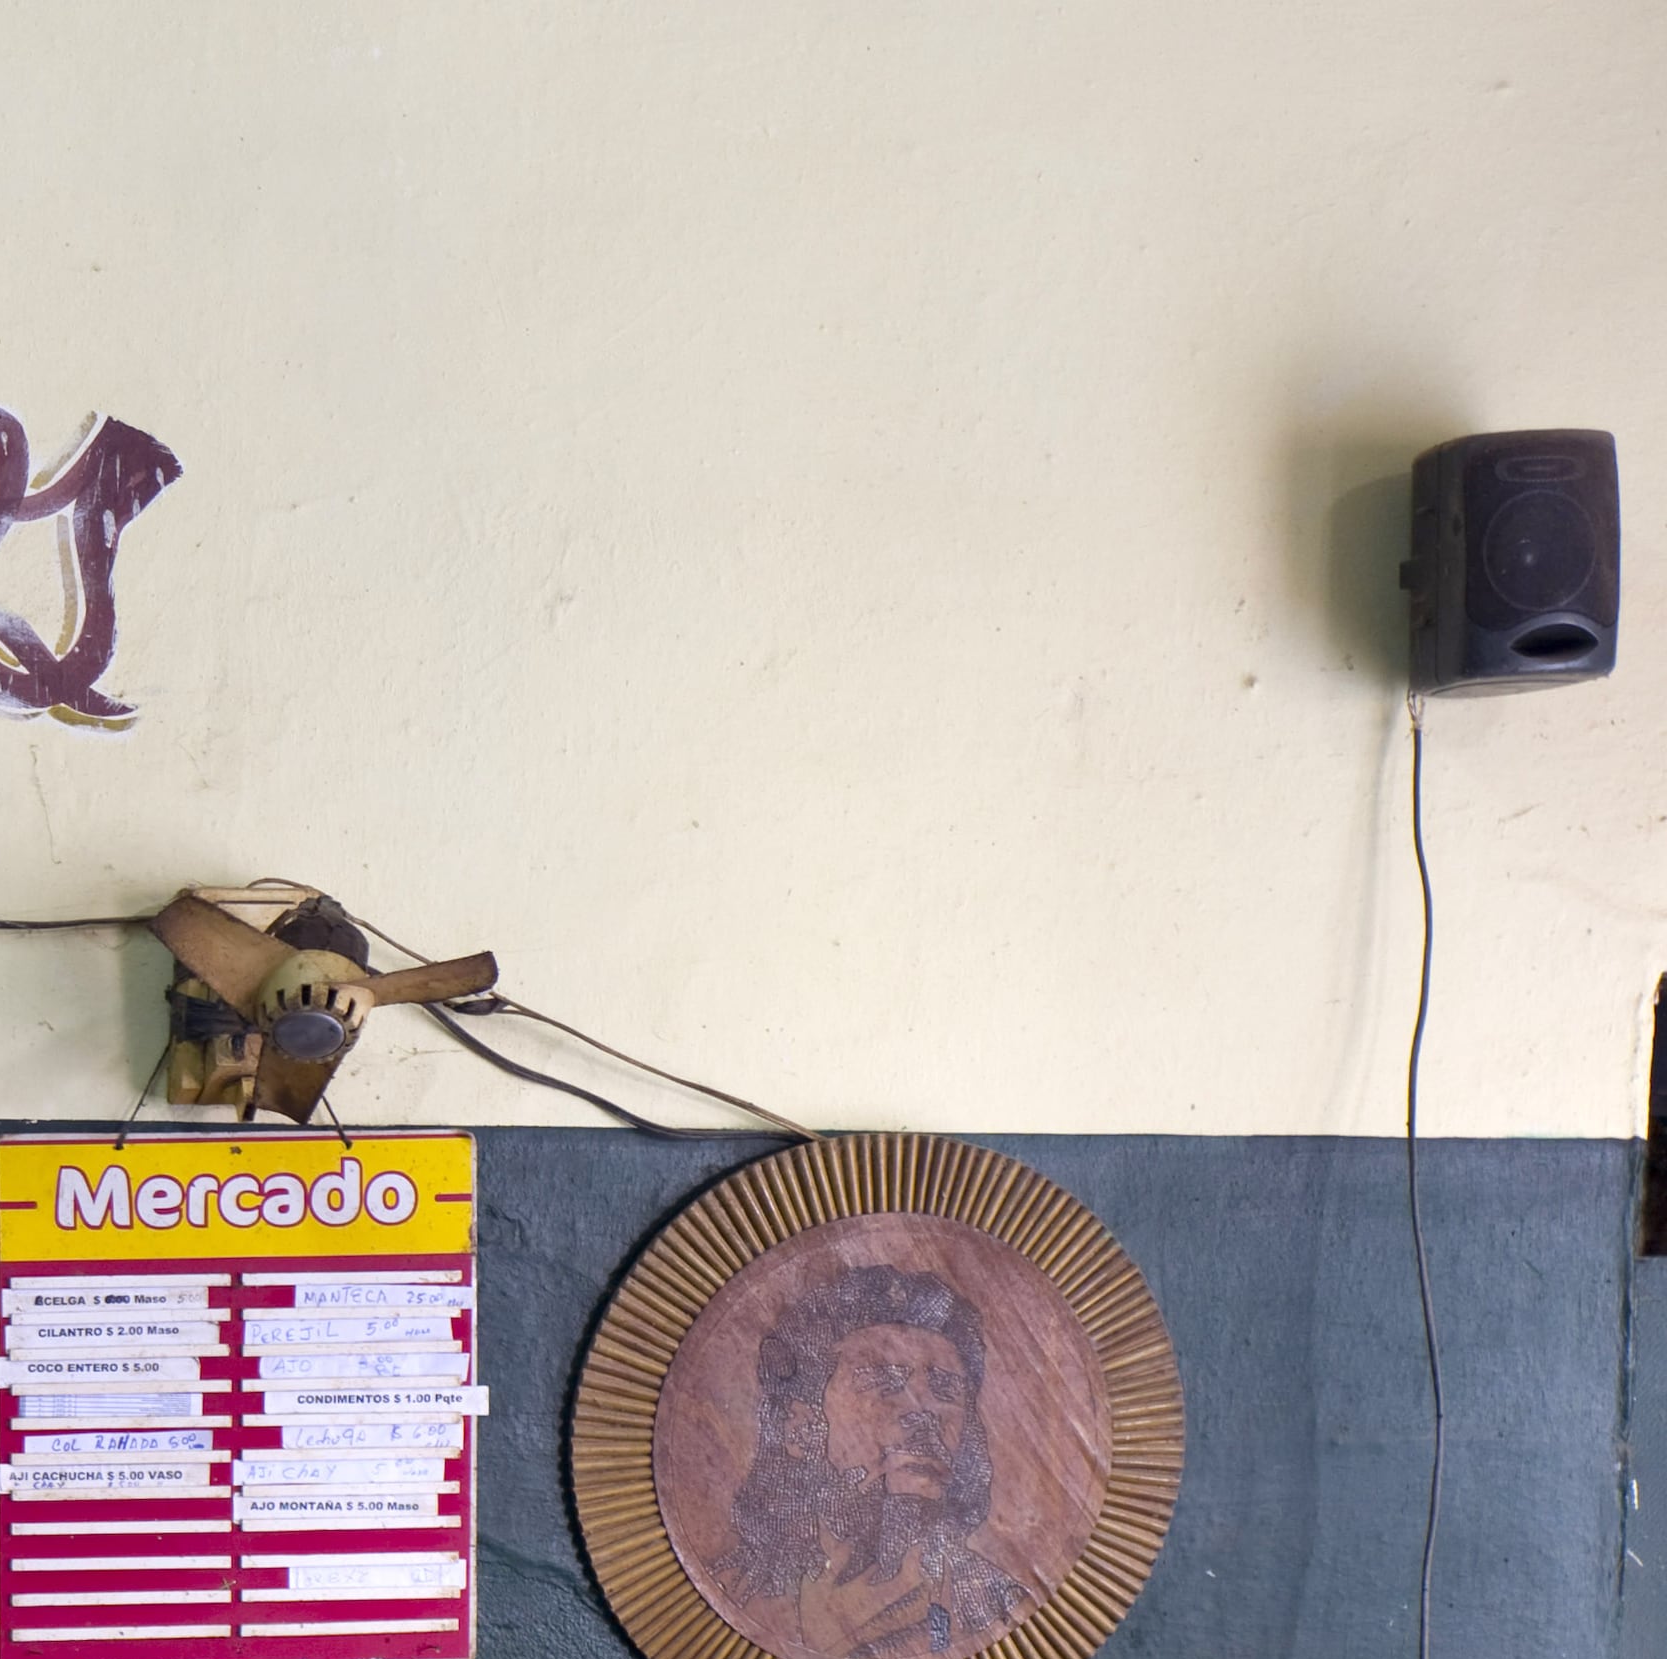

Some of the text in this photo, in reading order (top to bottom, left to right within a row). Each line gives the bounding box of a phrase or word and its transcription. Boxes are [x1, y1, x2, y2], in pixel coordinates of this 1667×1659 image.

[55, 1156, 417, 1231] Mercado
[134, 1294, 167, 1305] Maso
[38, 1327, 103, 1338] CILANTRO
[117, 1326, 144, 1336] 2.00
[147, 1326, 180, 1336] Maso
[28, 1363, 64, 1374] COCO
[67, 1363, 118, 1373] ENTERO
[133, 1363, 160, 1373] 5.00
[297, 1394, 390, 1404] CONDIMENTOS
[405, 1393, 431, 1404] 1.00
[435, 1393, 463, 1405] Pqte
[9, 1472, 29, 1482] AJI
[32, 1471, 104, 1482] CACHUCHA
[118, 1471, 145, 1481] 5.00
[148, 1470, 183, 1481] VASO
[250, 1502, 276, 1512] AJO
[279, 1500, 343, 1511] MONTAÑA
[357, 1501, 384, 1511] 5.00
[387, 1501, 420, 1511] Maso
